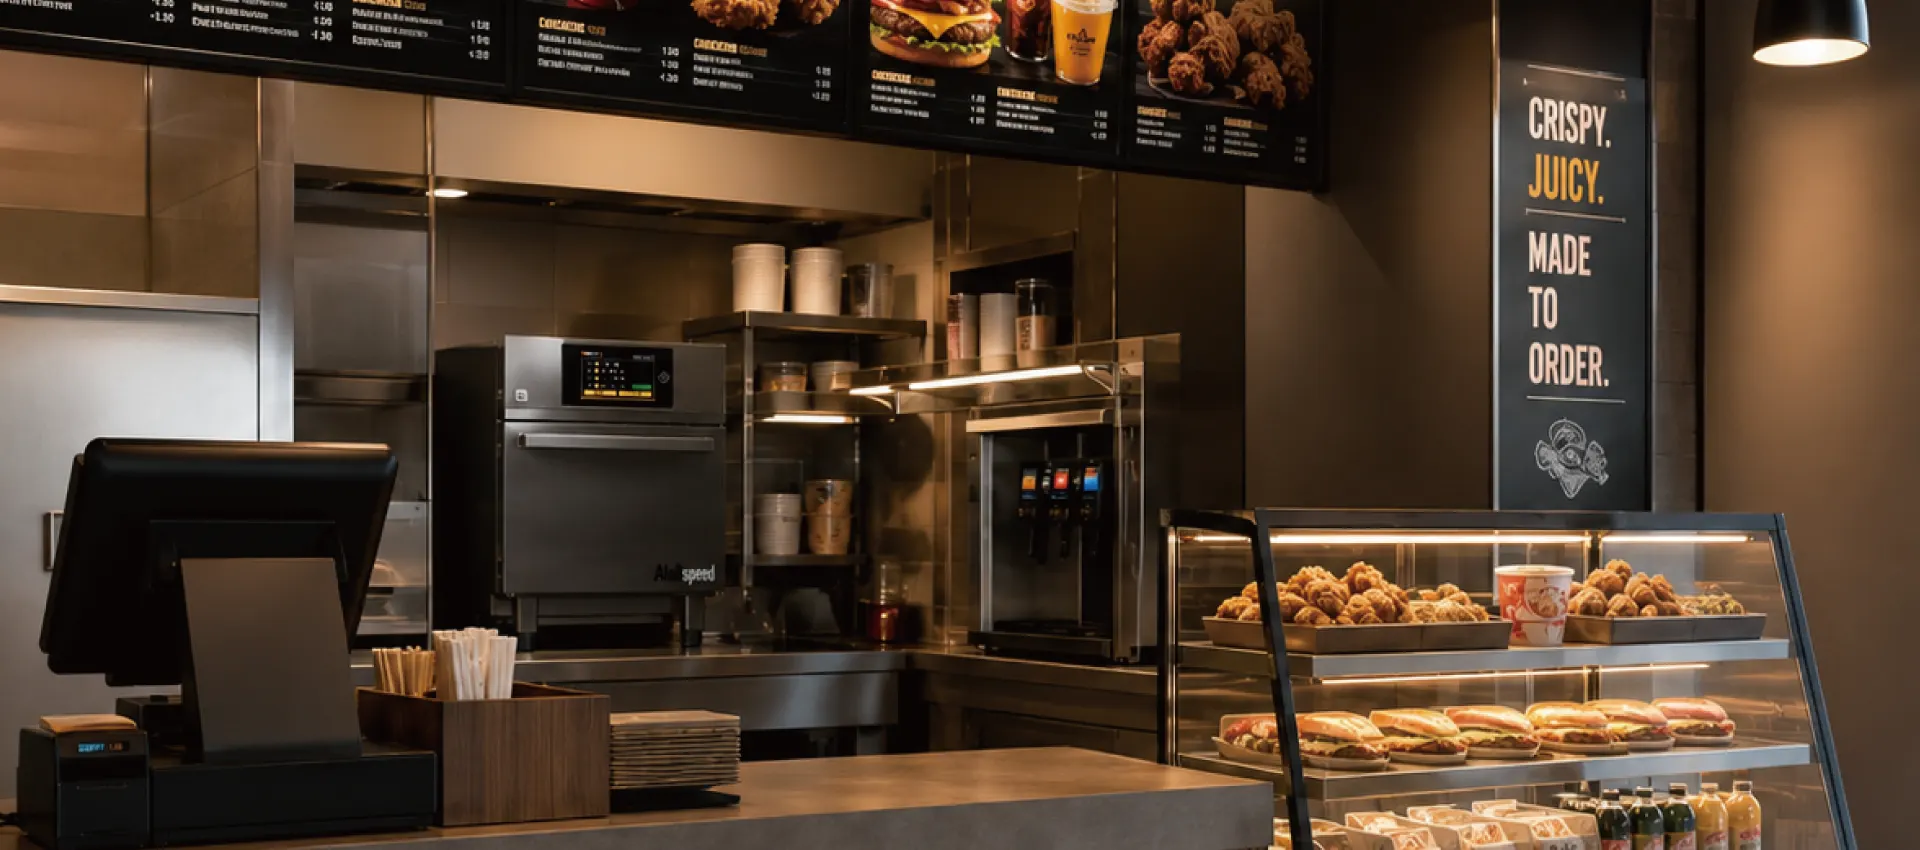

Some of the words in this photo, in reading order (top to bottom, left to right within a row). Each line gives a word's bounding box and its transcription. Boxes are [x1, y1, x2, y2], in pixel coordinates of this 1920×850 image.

[1528, 96, 1612, 148] CRISPY.
[1528, 153, 1605, 204] JUICY.
[1528, 230, 1592, 276] MADE
[1528, 286, 1558, 330] TO
[1528, 341, 1610, 387] ORDER.
